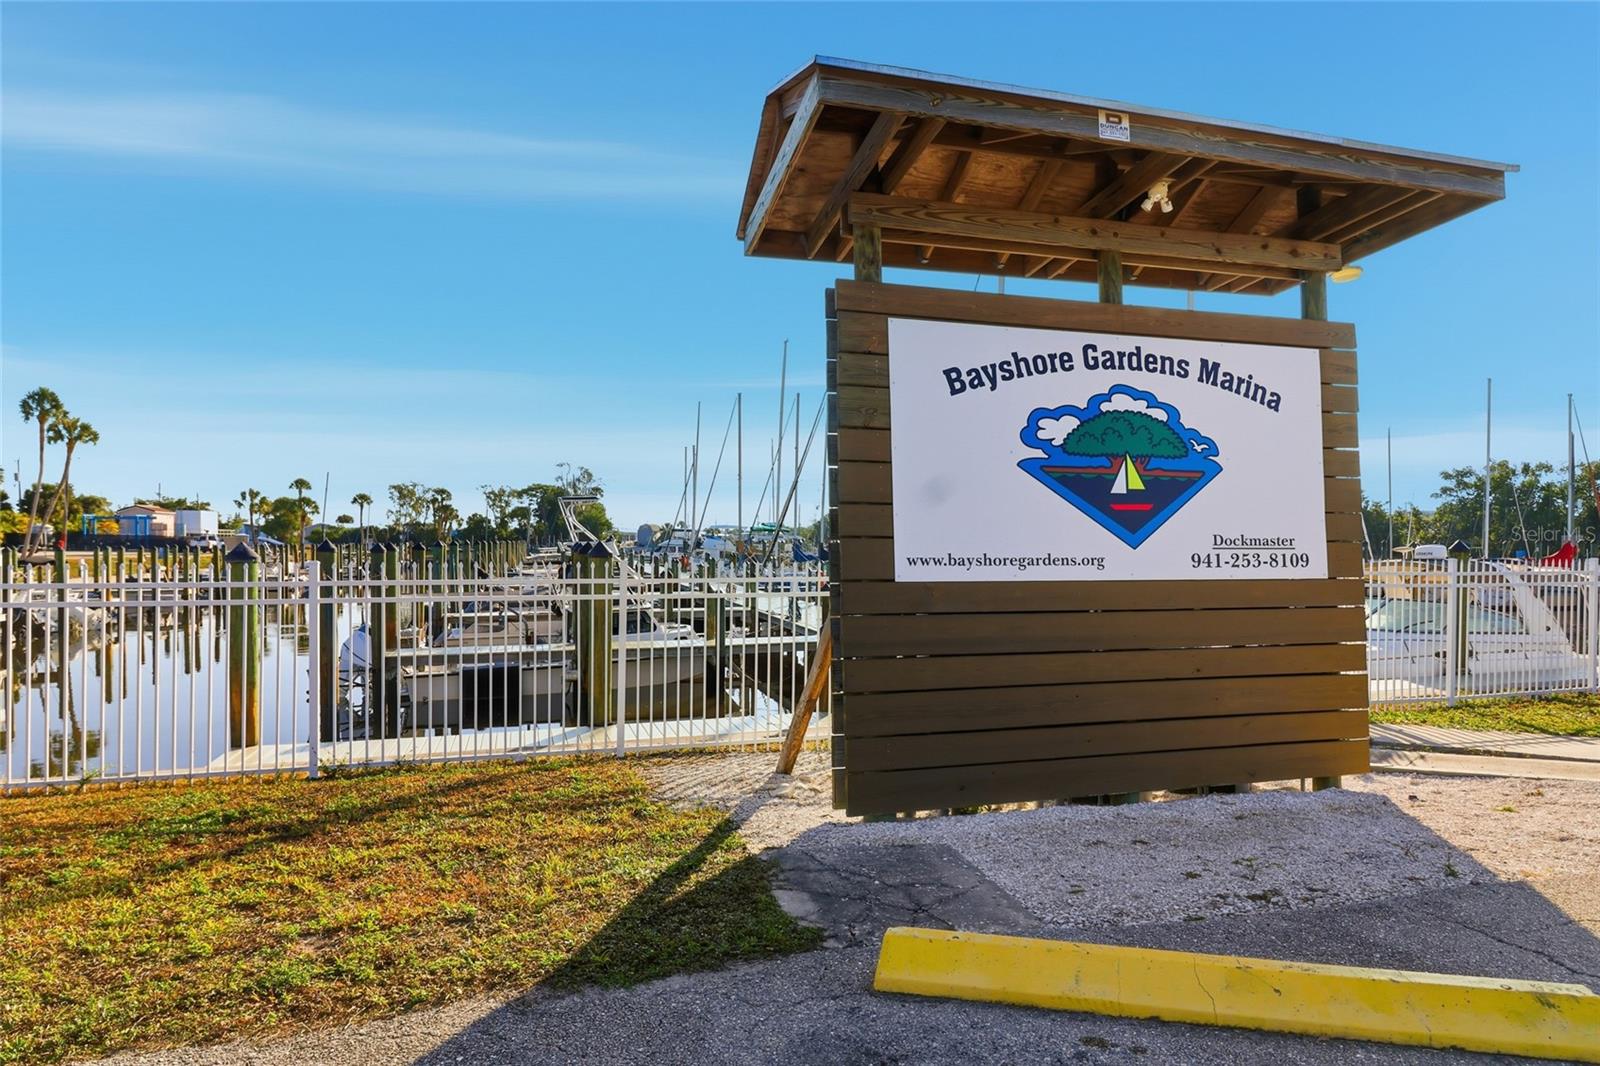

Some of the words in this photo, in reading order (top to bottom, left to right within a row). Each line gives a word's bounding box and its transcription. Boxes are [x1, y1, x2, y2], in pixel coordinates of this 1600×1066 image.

[1100, 123, 1129, 131] DUNCAN
[942, 352, 1075, 397] Bayshore
[1082, 343, 1190, 379] Gardens
[1197, 357, 1282, 413] Marina
[1213, 534, 1295, 547] Dockmaster
[906, 552, 1105, 571] www.bayshoregardens.org
[1190, 552, 1310, 569] 941-253-8109
